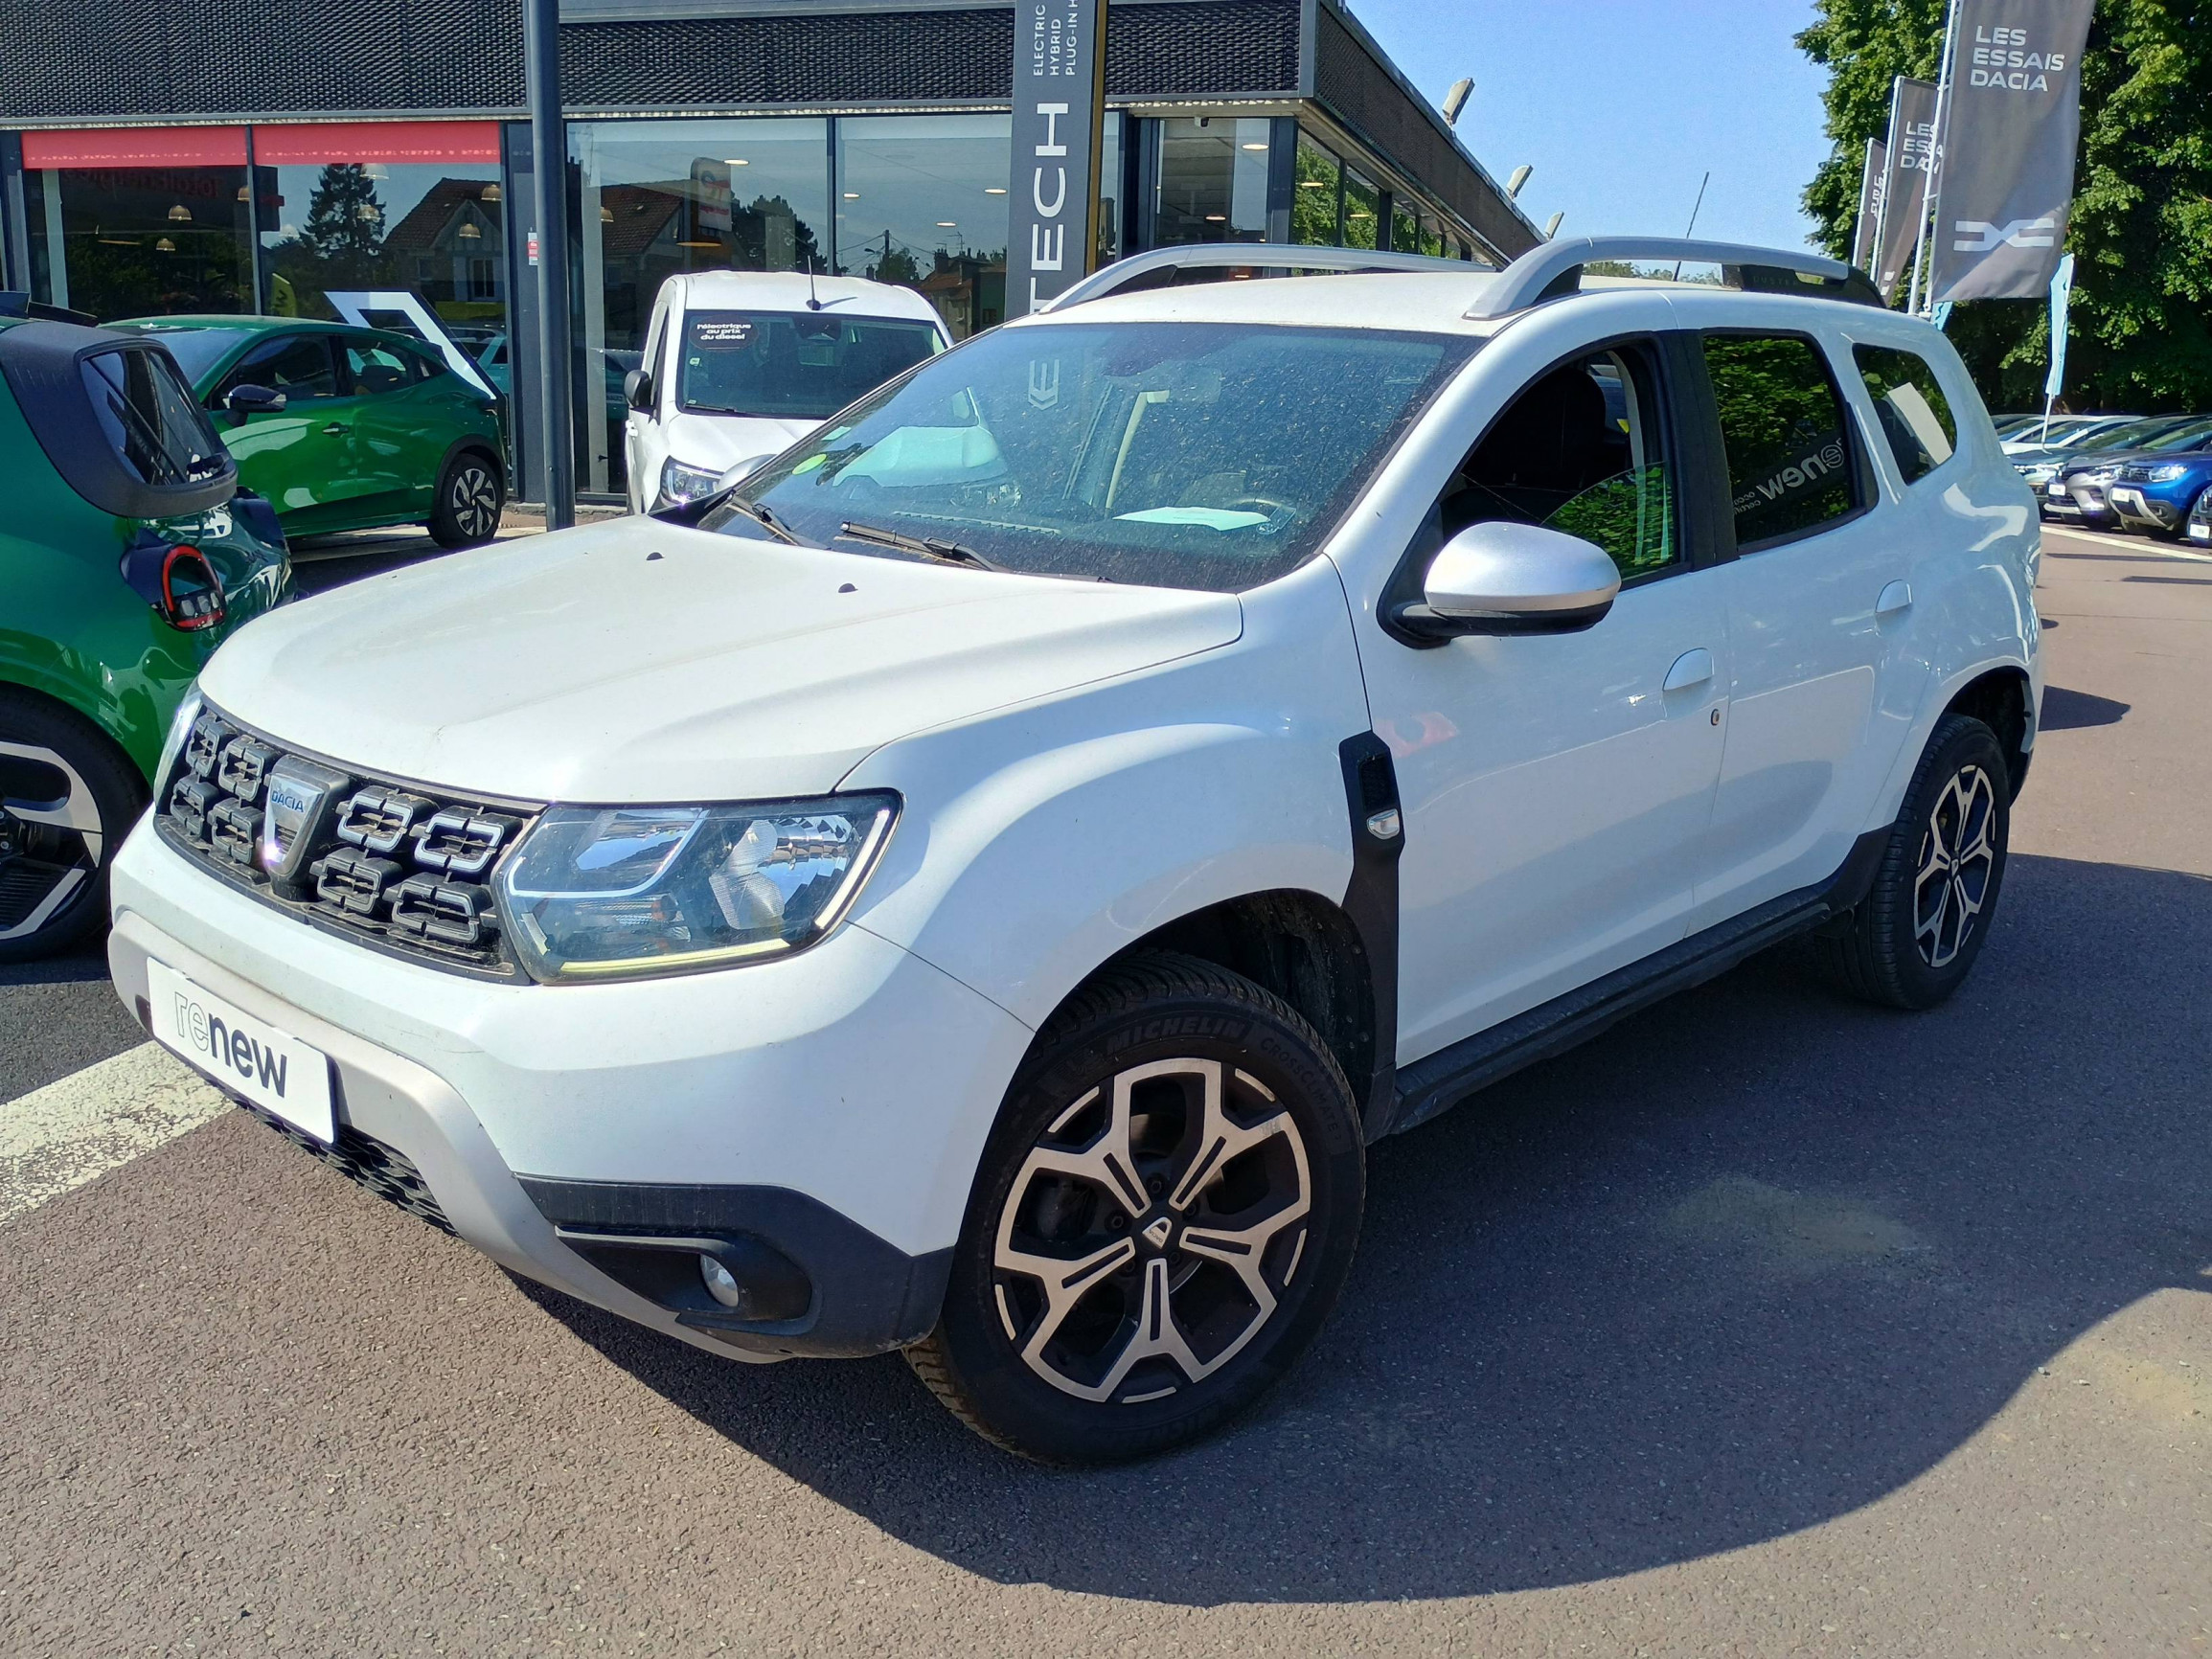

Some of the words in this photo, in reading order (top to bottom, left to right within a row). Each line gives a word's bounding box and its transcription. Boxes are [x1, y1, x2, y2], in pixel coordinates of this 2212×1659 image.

[1033, 4, 1046, 77] ELECTRIC
[1049, 18, 1061, 77] HYBRID
[1065, 12, 1078, 77] PLUG-IN
[1975, 25, 2027, 46] LES
[1973, 47, 2065, 72] ESSAIS
[1970, 69, 2048, 92] DACIA
[1900, 154, 1941, 174] DACI
[271, 789, 305, 813] DACIA
[174, 991, 288, 1099] renew
[1106, 1016, 1248, 1053] MICHELIN
